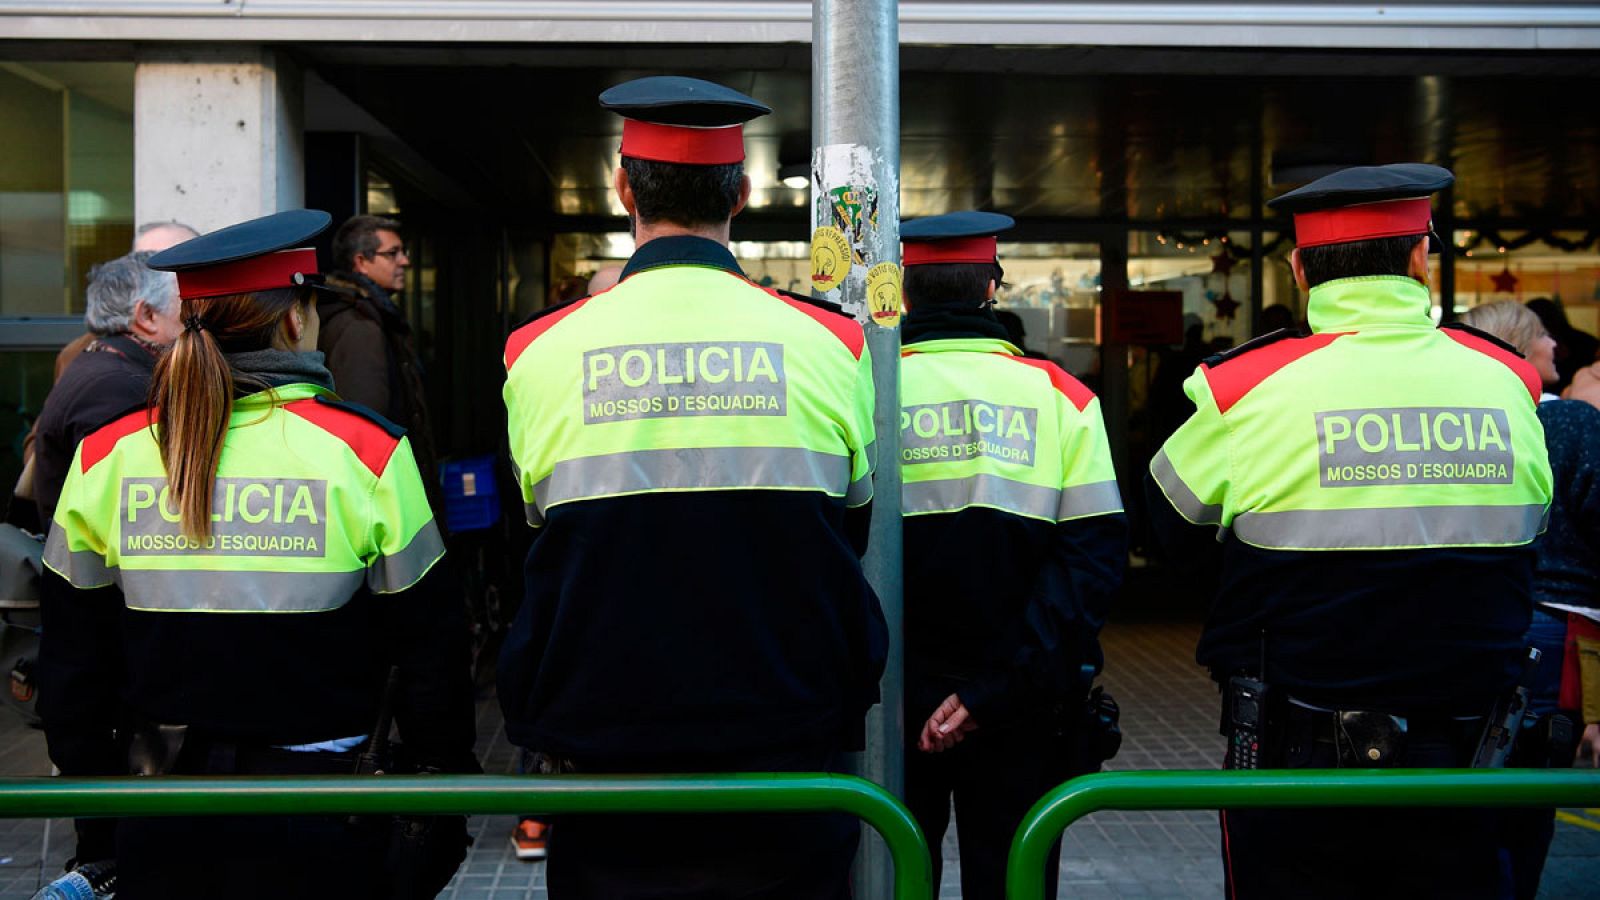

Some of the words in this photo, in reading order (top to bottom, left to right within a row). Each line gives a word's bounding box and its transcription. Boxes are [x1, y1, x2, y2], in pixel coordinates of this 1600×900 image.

[588, 346, 779, 392] POLICIA
[590, 396, 663, 418] MOSSOS
[1323, 411, 1507, 454] POLICIA
[902, 445, 949, 461] OSSOS
[1327, 463, 1401, 481] MOSSOS
